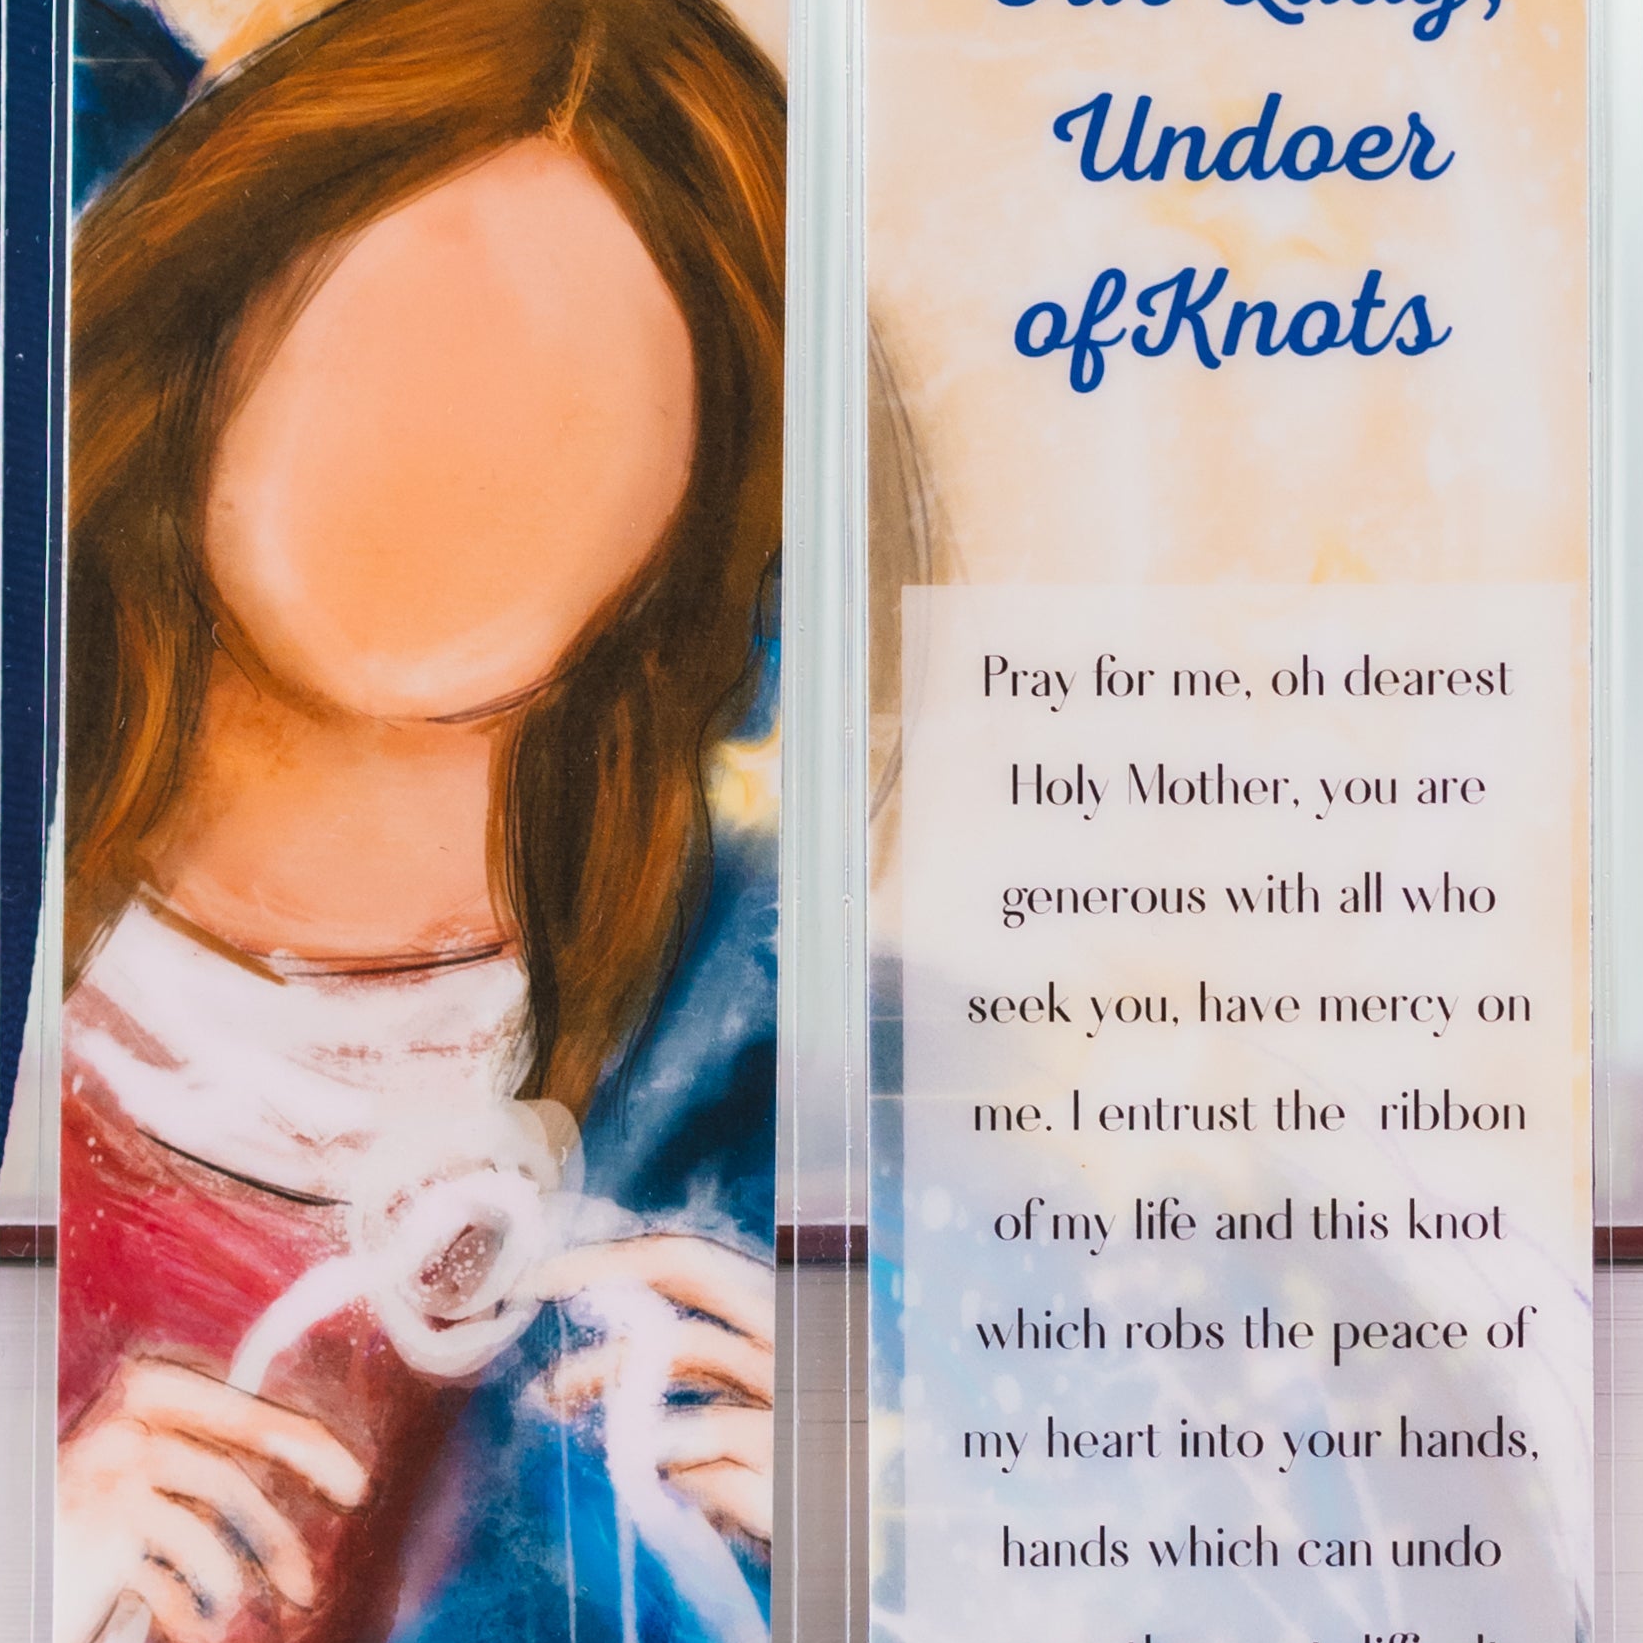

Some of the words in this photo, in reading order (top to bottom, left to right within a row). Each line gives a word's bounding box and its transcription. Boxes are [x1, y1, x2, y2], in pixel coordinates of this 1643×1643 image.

[1051, 90, 1457, 184] Undoer
[983, 653, 1077, 714] Pray
[1094, 652, 1157, 698] for
[1172, 668, 1253, 702] me,
[1270, 652, 1326, 698] oh
[1342, 652, 1509, 698] dearest
[1010, 762, 1110, 822] Holy
[1127, 762, 1301, 810] Mother,
[1315, 776, 1398, 822] you
[1415, 776, 1487, 806] are
[1001, 885, 1208, 930] generous
[1224, 870, 1321, 916] with
[1338, 870, 1383, 915] all
[1400, 869, 1497, 915] who
[966, 979, 1073, 1025] seek
[1084, 994, 1180, 1040] you,
[1198, 979, 1302, 1024] have
[1318, 994, 1459, 1039] mercy
[1476, 994, 1532, 1024] on
[973, 1103, 1054, 1133] me.
[1072, 1088, 1081, 1132] I
[1097, 1095, 1253, 1133] entrust
[1274, 1087, 1347, 1133] the
[1380, 1087, 1527, 1132] ribbon
[992, 1196, 1047, 1242] of
[1051, 1212, 1116, 1258] my
[1134, 1195, 1198, 1242] life
[1214, 1196, 1294, 1242] and
[1311, 1196, 1390, 1242] this
[1408, 1196, 1503, 1241] knot
[974, 1305, 1107, 1351] which
[1124, 1305, 1226, 1351] robs
[1244, 1305, 1315, 1351] the
[1332, 1320, 1469, 1368] peace
[1485, 1304, 1539, 1350] of
[963, 1430, 1028, 1475] my
[1046, 1414, 1158, 1460] heart
[1179, 1417, 1266, 1459] into
[1277, 1429, 1384, 1475] your
[1399, 1413, 1540, 1463] hands,
[1001, 1523, 1131, 1569] hands
[1147, 1523, 1280, 1569] which
[1296, 1538, 1373, 1569] can
[1390, 1522, 1503, 1569] undo
